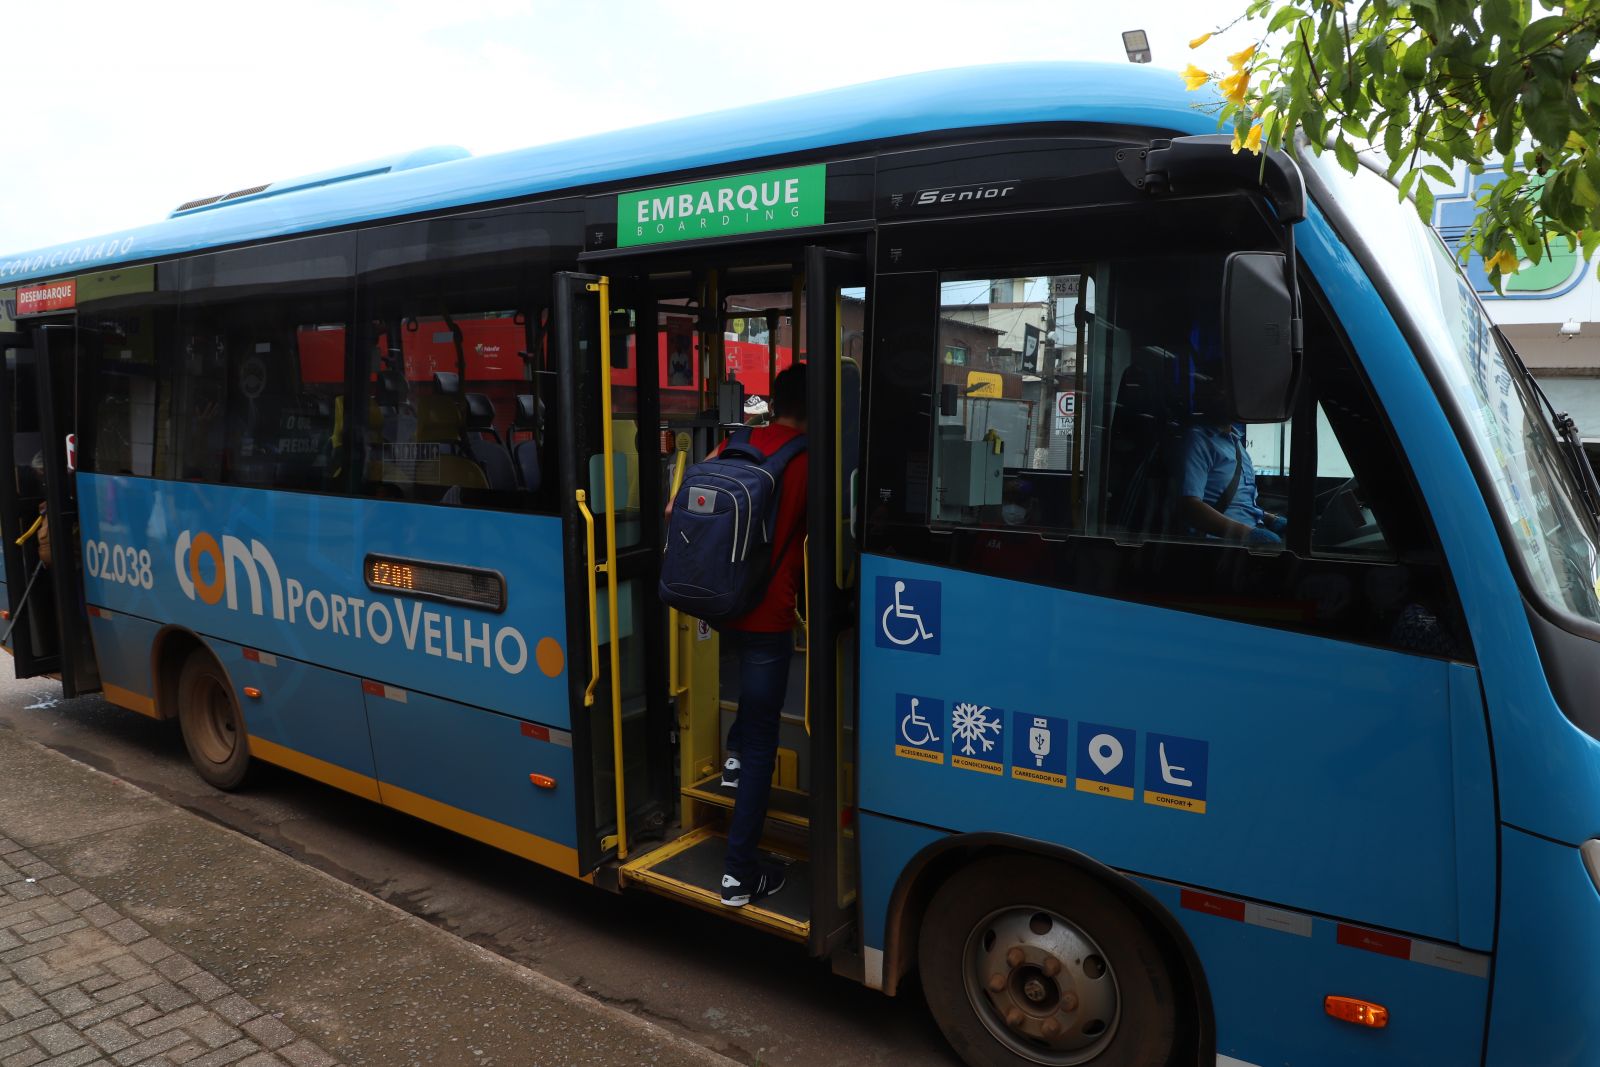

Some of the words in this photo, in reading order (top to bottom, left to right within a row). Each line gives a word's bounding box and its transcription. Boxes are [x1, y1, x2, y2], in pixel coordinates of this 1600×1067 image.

[637, 178, 799, 223] EMBARQUE
[917, 186, 1015, 205] Senior
[637, 206, 799, 236] BOARDING
[20, 285, 72, 304] DESEMBARQUE
[1065, 397, 1073, 412] E
[83, 539, 154, 590] 02.038
[960, 759, 1002, 772] CONDICIONADO
[1014, 769, 1052, 782] CARREGADOR
[1098, 785, 1110, 793] GPS
